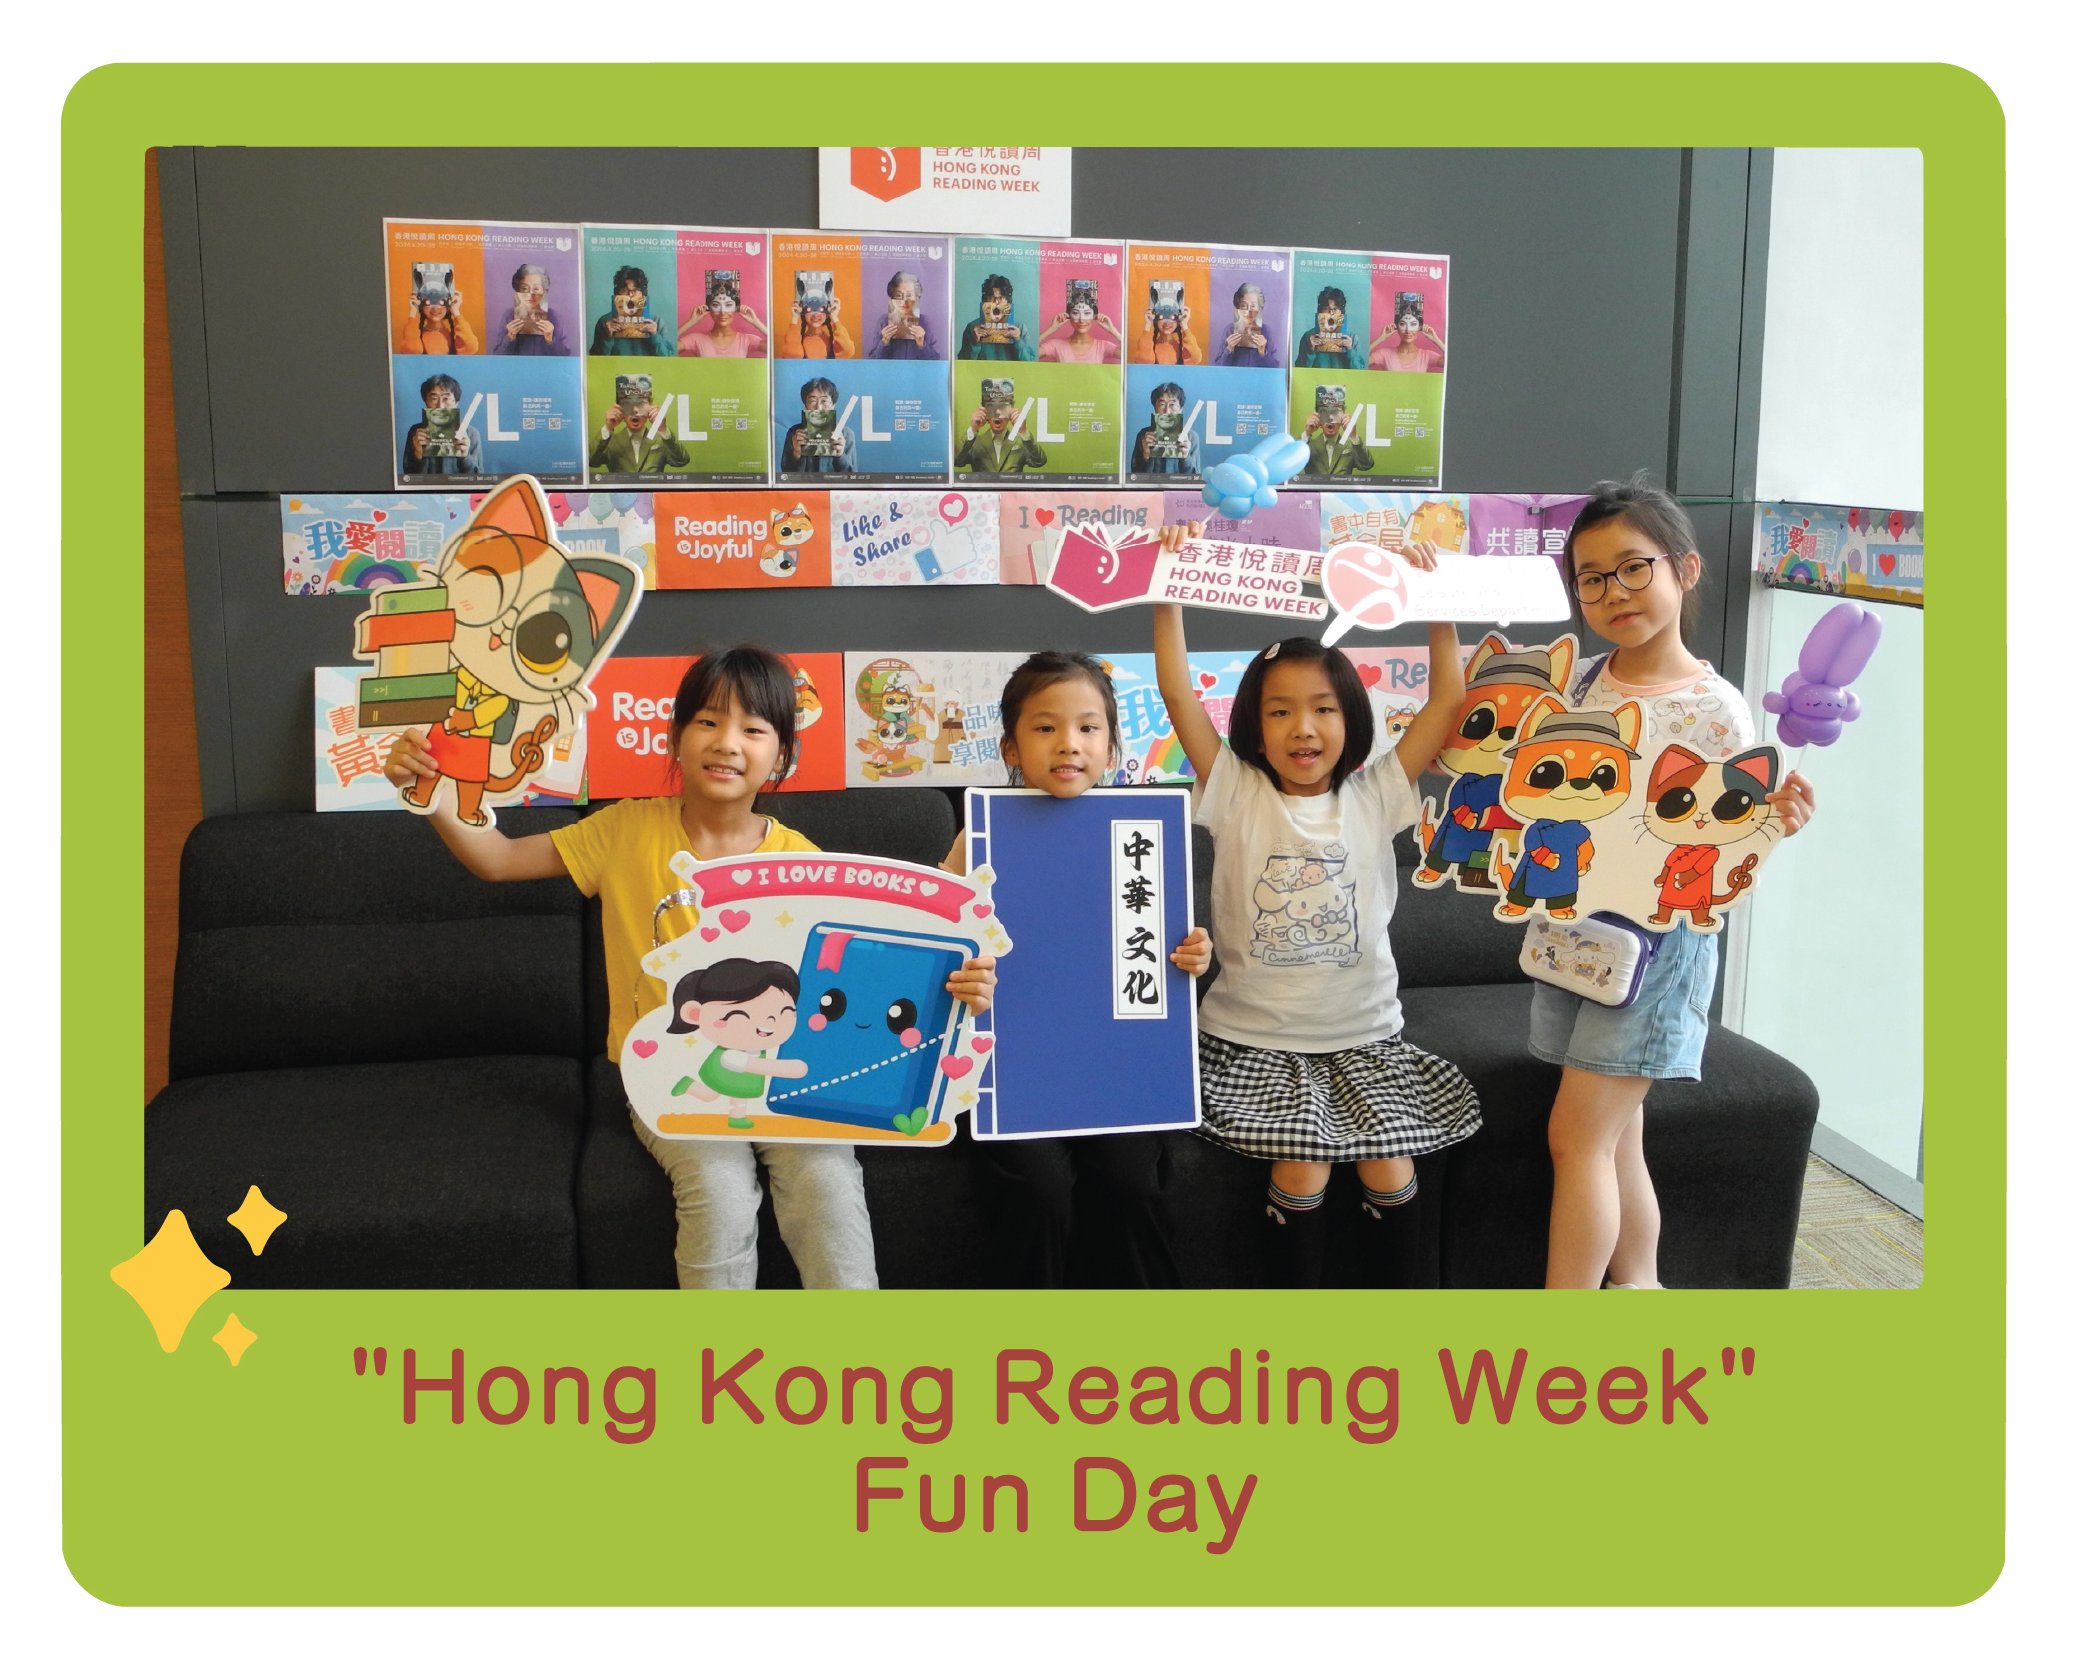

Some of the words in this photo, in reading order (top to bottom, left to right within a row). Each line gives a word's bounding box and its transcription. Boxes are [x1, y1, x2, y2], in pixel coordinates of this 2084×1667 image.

[933, 161, 977, 174] HONG
[980, 163, 1021, 176] KONG
[933, 177, 997, 191] READING
[1000, 180, 1041, 192] WEEK
[438, 234, 464, 242] HONG
[466, 234, 490, 242] KONG
[492, 235, 529, 244] READING
[530, 236, 554, 244] WEEK
[633, 238, 658, 246] HONG
[660, 239, 683, 247] KONG
[685, 240, 720, 248] READING
[721, 241, 744, 249] WEEK
[844, 244, 868, 252] KONG
[869, 244, 903, 252] READING
[904, 246, 926, 254] WEEK
[1000, 248, 1024, 256] HONG
[1024, 248, 1047, 256] KONG
[1047, 250, 1081, 258] READING
[1082, 252, 1102, 260] WEEK
[1172, 254, 1195, 262] HONG
[1196, 256, 1217, 264] KONG
[1218, 257, 1250, 265] READING
[1250, 258, 1270, 266] WEEK
[1378, 264, 1408, 272] READING
[1410, 264, 1428, 273] WEEK
[674, 514, 768, 541] Reading
[842, 514, 882, 544] Like
[889, 501, 904, 523] &
[1018, 506, 1029, 529] I
[1057, 504, 1149, 528] Reading
[1330, 509, 1399, 534] 書中自有
[305, 520, 444, 560] 我愛閱讀
[689, 538, 753, 564] Joyful
[852, 531, 912, 567] Share
[1486, 526, 1573, 555] 共讀宣
[1770, 523, 1837, 564] 我愛閱讀
[1178, 542, 1325, 577] 香港悅讀周
[1169, 567, 1232, 586] HONG
[1237, 575, 1298, 594] KONG
[1164, 584, 1258, 607] READING
[1264, 596, 1324, 616] WEEK
[620, 730, 634, 744] is
[758, 867, 770, 885] I
[777, 865, 837, 883] LOVE
[844, 867, 916, 894] BOOKS
[1121, 830, 1159, 1005] 中華文化
